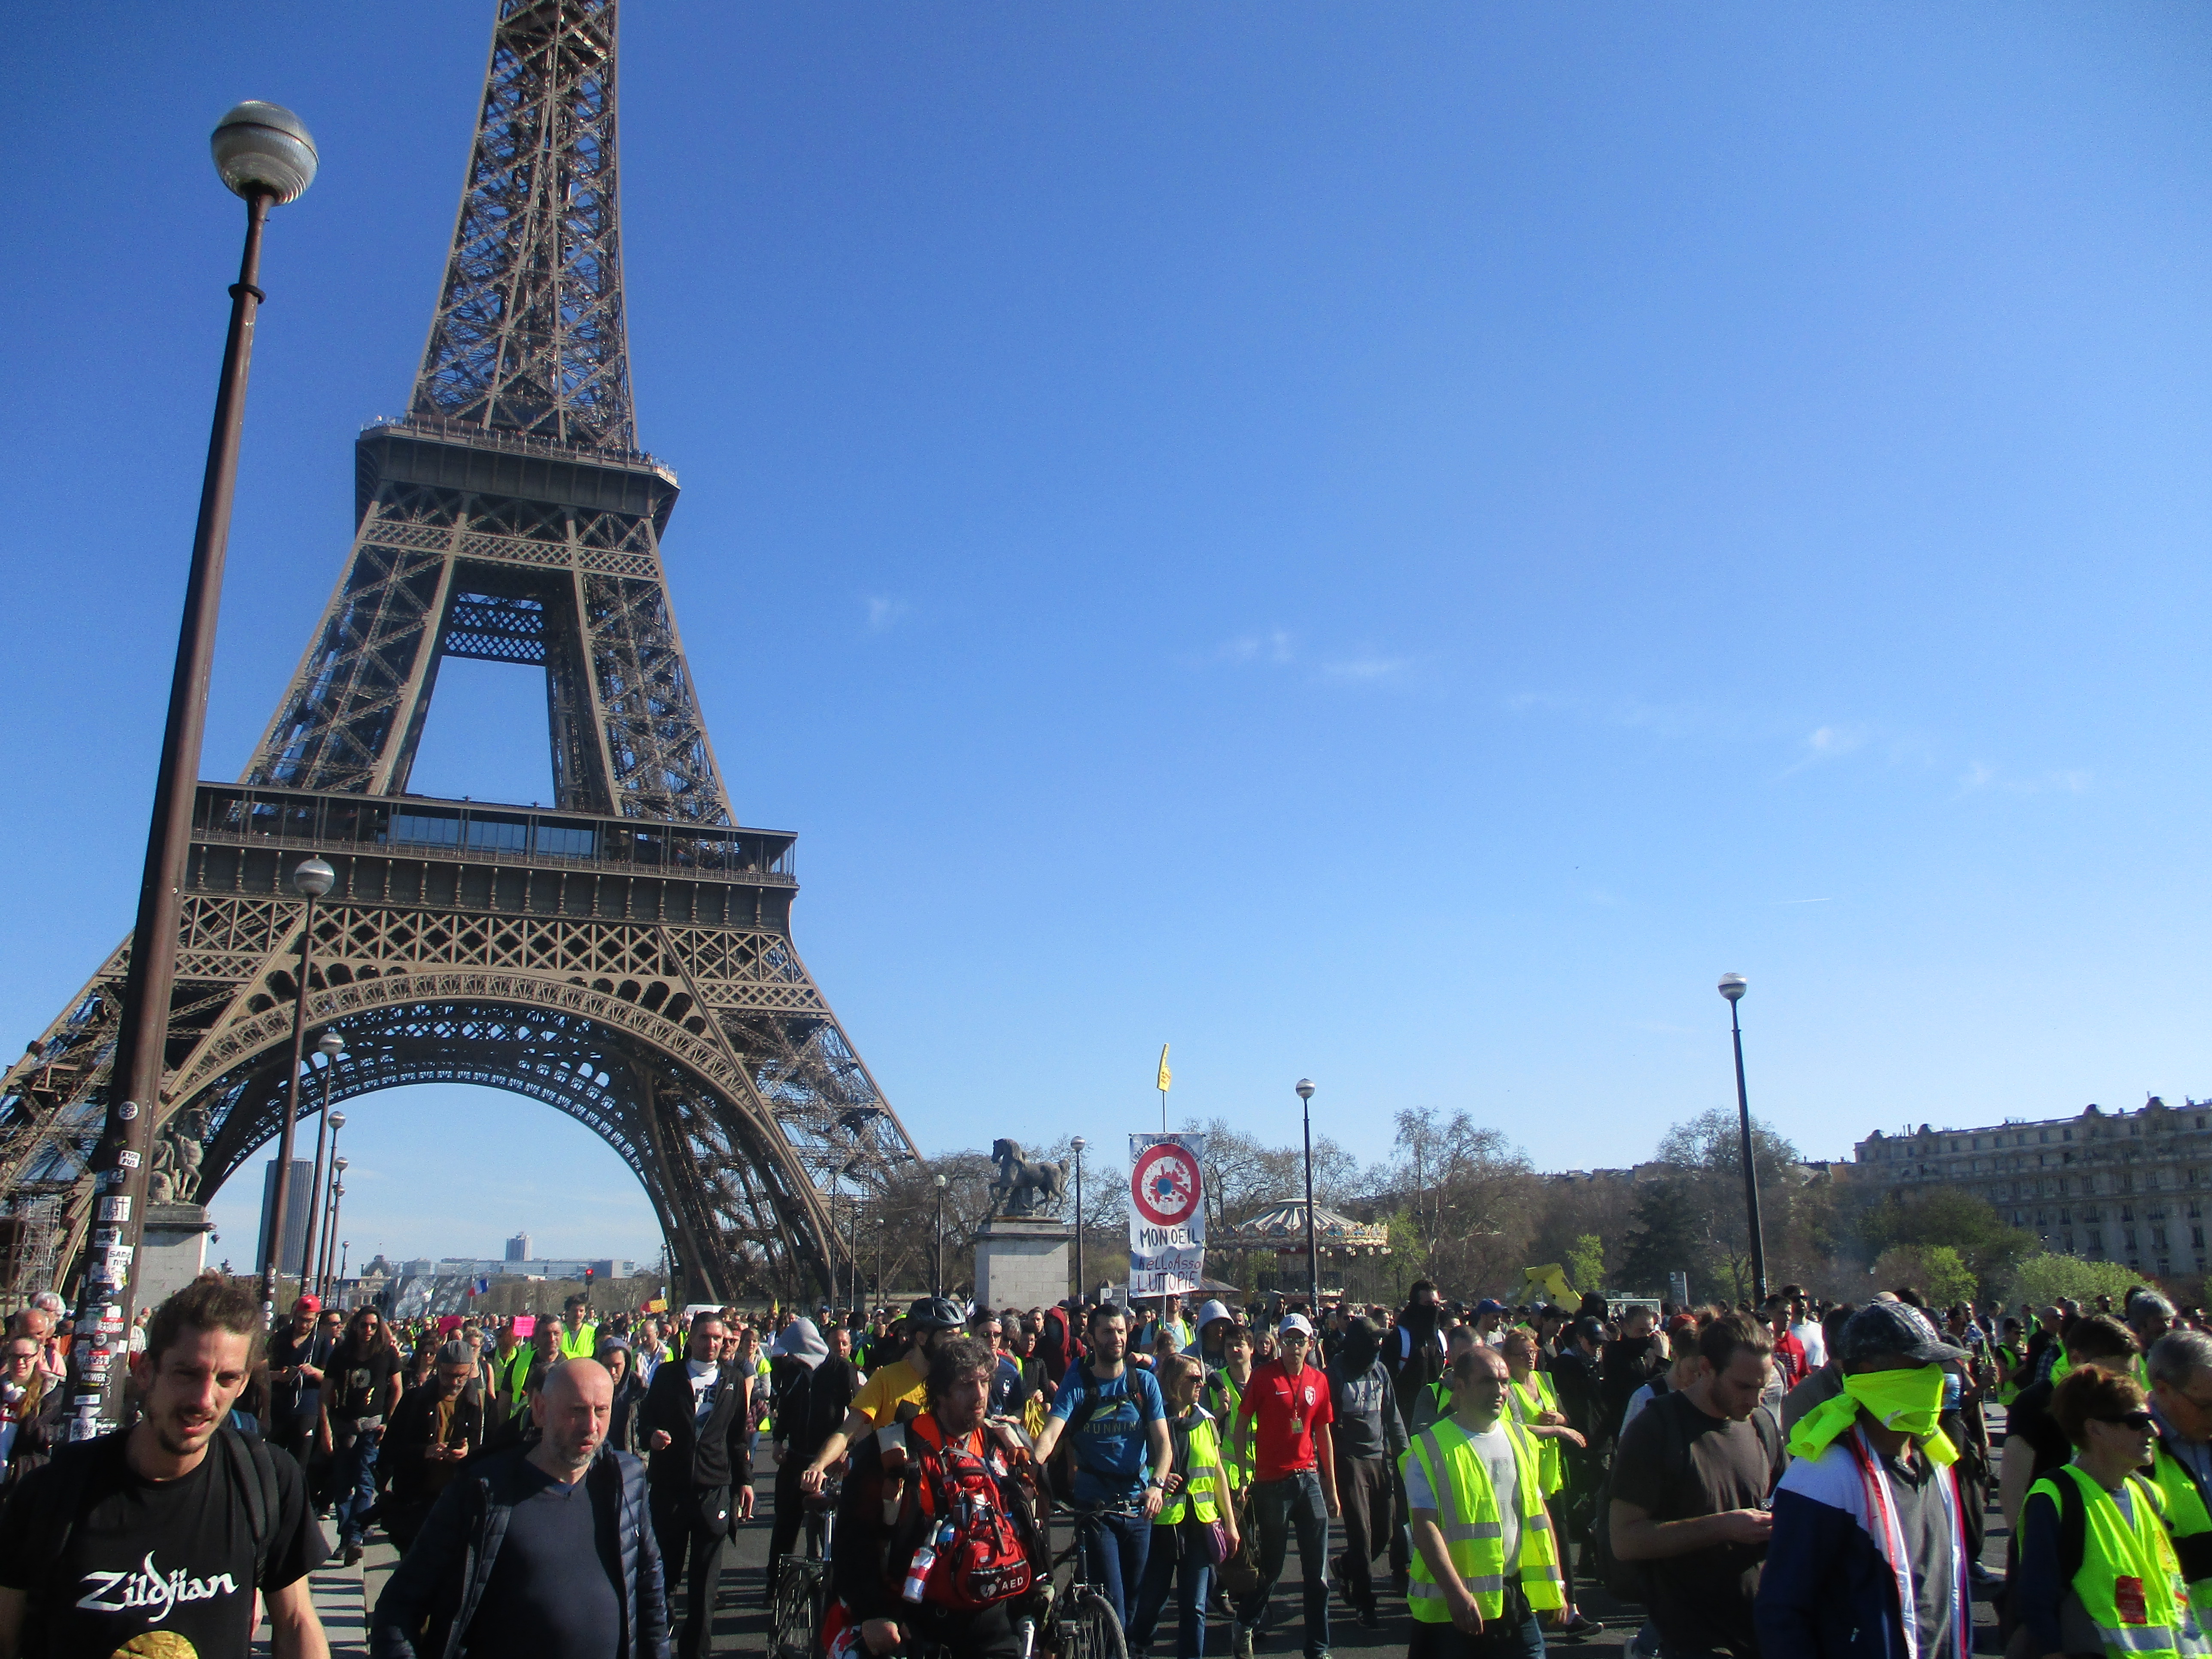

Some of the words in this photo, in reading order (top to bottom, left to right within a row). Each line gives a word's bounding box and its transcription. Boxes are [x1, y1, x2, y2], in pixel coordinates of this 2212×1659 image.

[1139, 1228, 1168, 1248] MON
[1171, 1228, 1200, 1244] OEIL
[76, 1550, 239, 1623] Zildjian
[1001, 1576, 1024, 1591] AED
